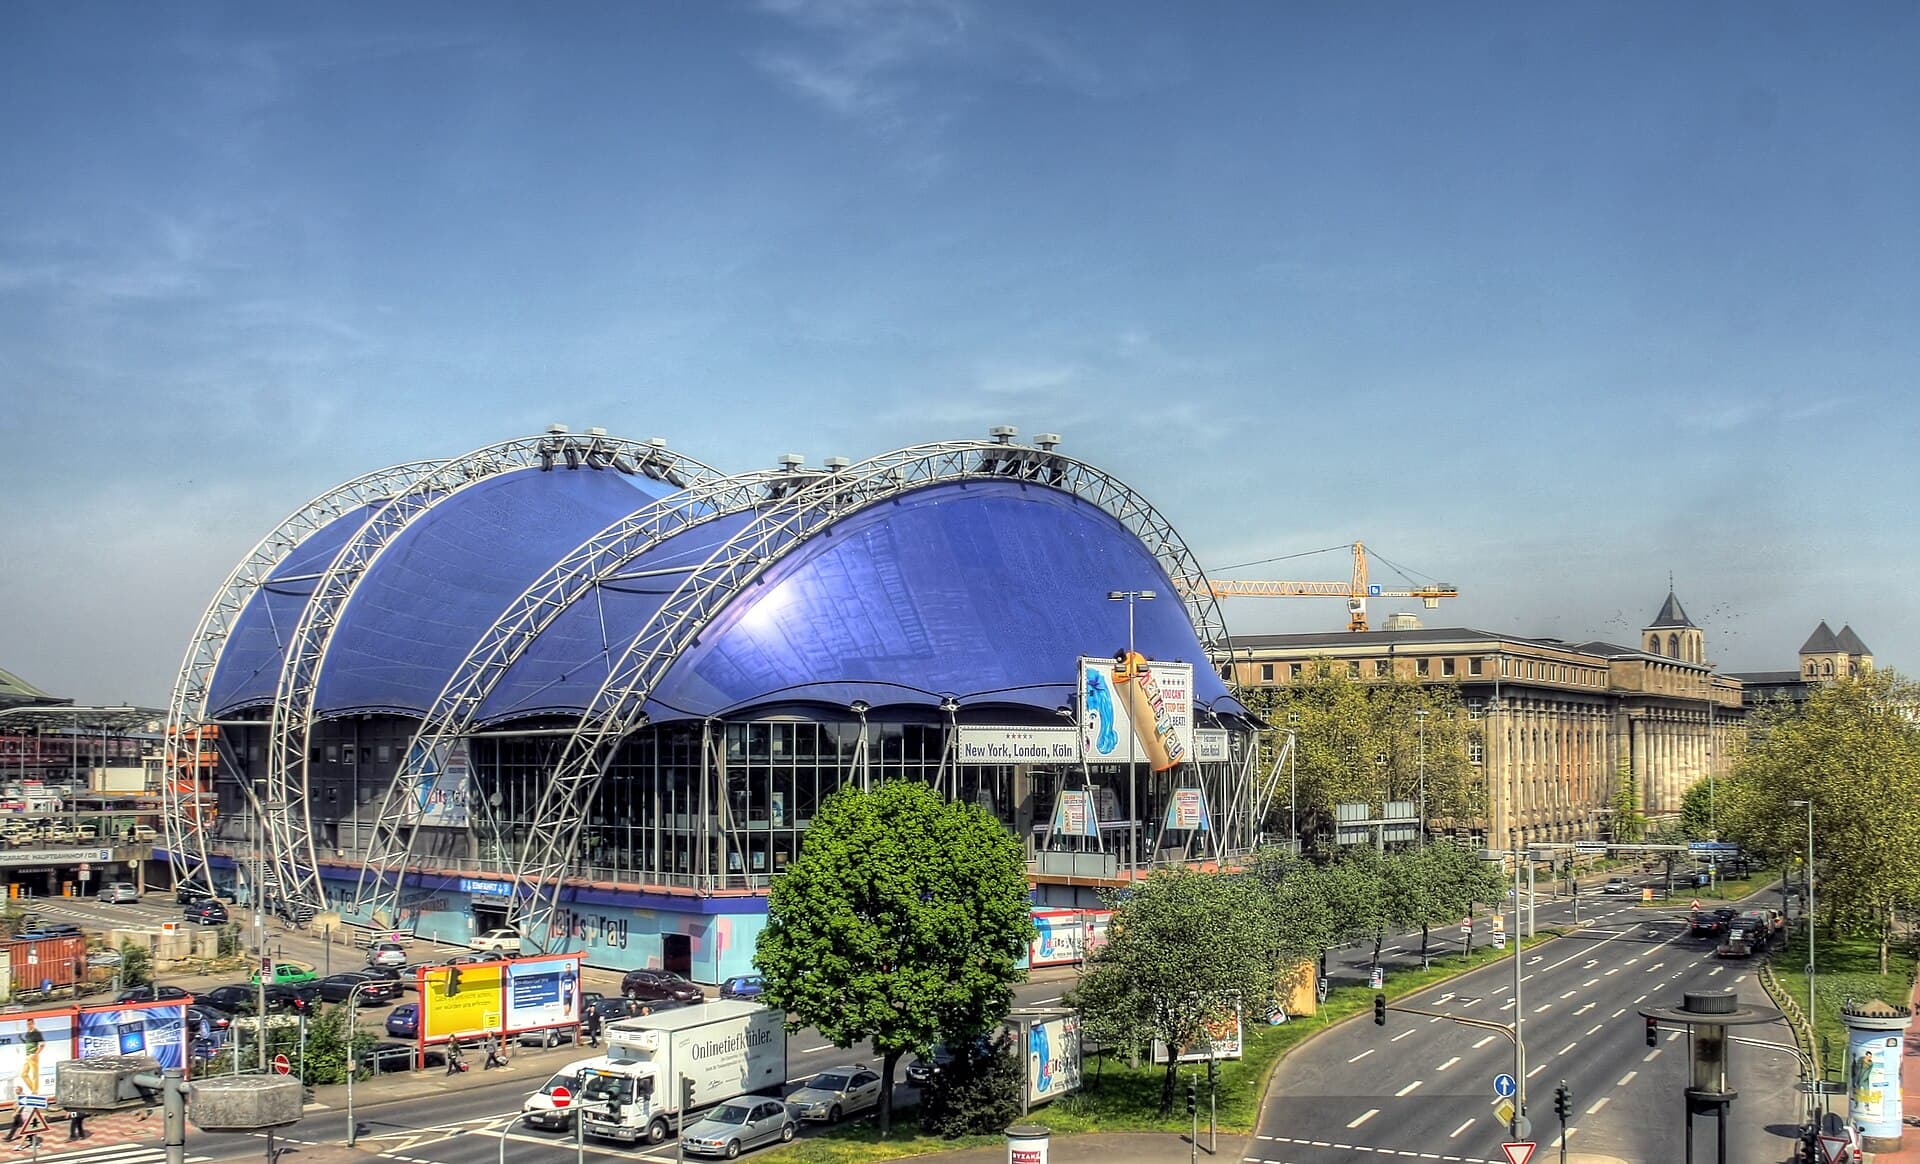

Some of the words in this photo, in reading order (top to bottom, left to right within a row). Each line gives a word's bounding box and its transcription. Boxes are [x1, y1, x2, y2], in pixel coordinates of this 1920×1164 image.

[965, 744, 985, 757] New
[987, 744, 1011, 759] York,
[1014, 744, 1050, 759] London,
[1053, 744, 1073, 757] Köln
[692, 1029, 773, 1061] Onlinetiefkühler.
